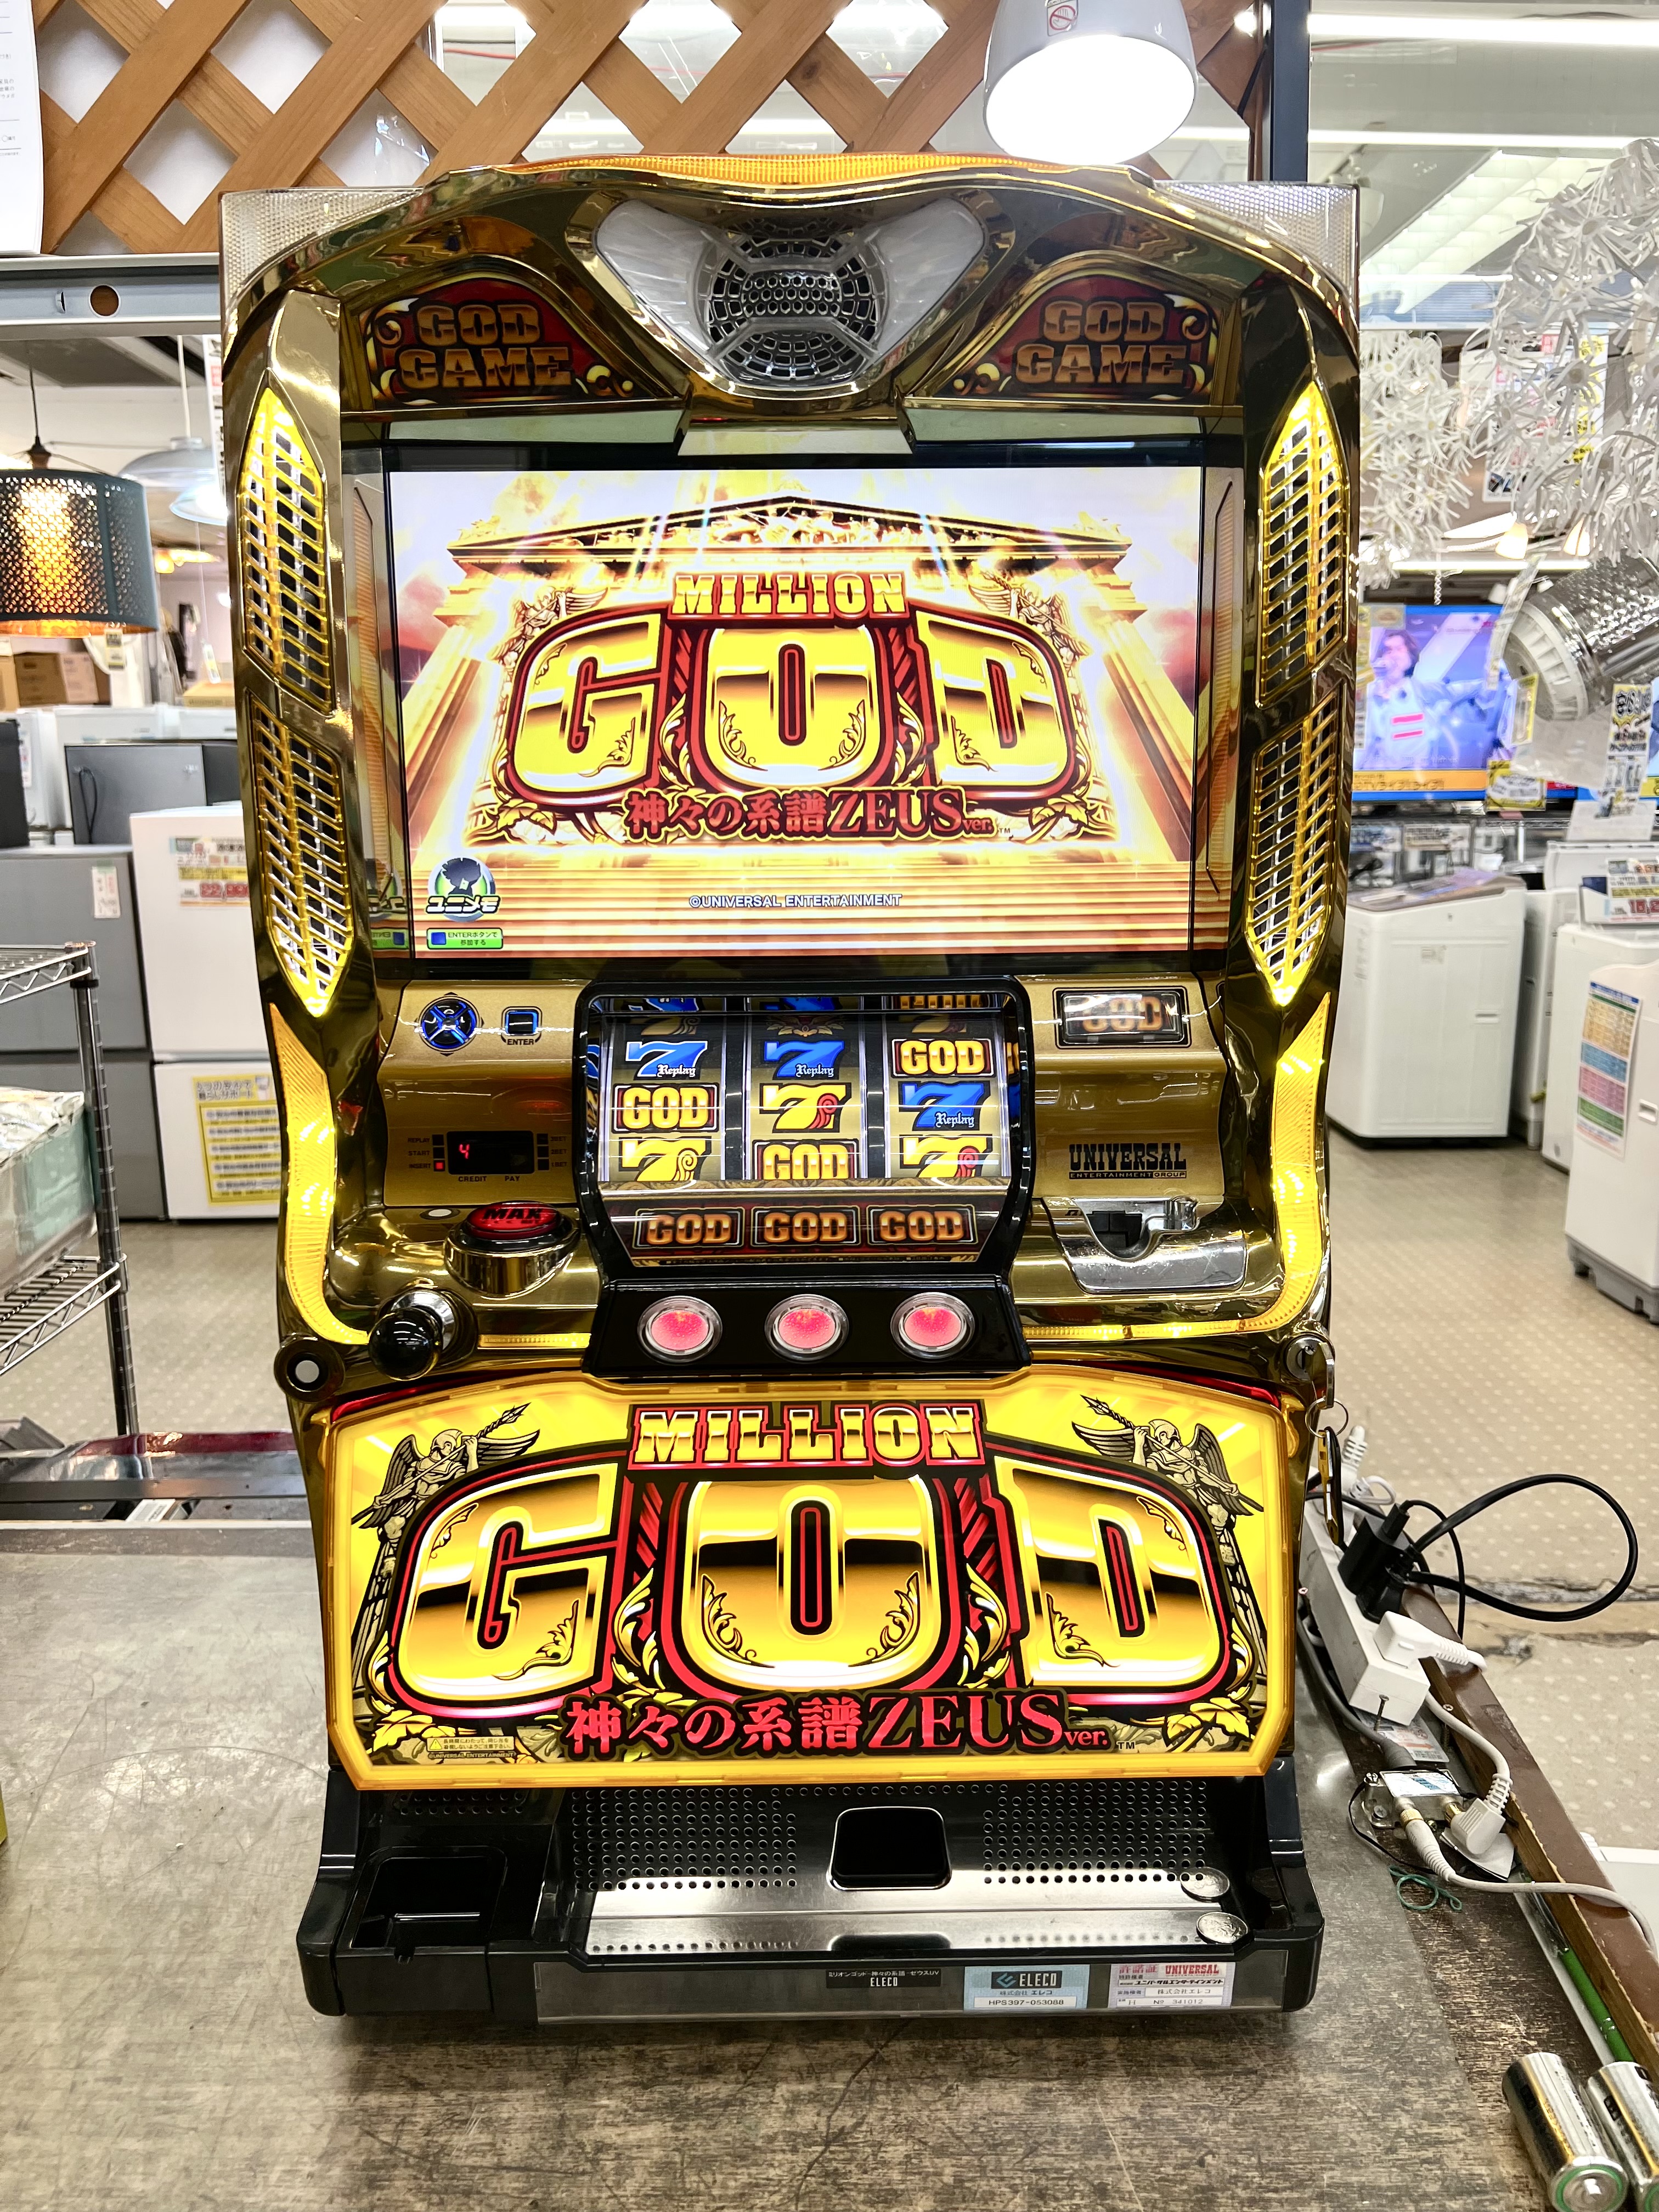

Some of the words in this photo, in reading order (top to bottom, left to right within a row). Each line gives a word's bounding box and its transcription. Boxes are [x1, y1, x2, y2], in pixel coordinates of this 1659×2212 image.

[417, 304, 540, 346] GOD
[1043, 301, 1165, 342] GOD
[399, 347, 572, 389] GAME
[1015, 345, 1186, 383] GAME
[674, 574, 906, 616] MILLION
[511, 611, 1071, 790] GOD
[426, 894, 500, 914] ユニメモ
[786, 894, 902, 908] ENTERTAINMENT
[1081, 995, 1163, 1032] GOD
[657, 1064, 696, 1078] Replay
[795, 1063, 834, 1078] Replay
[901, 1040, 984, 1075] GOD
[623, 1087, 709, 1130] GOD
[935, 1111, 974, 1128] Replay
[459, 1144, 470, 1159] 4
[763, 1144, 849, 1180] GOD
[1069, 1143, 1187, 1171] UNIVERSAL
[646, 1214, 731, 1244] GOD
[764, 1212, 847, 1243] GOD
[880, 1210, 964, 1242] GOD
[635, 1406, 982, 1464] MILLION
[403, 1459, 1221, 1700] GOD
[870, 1977, 898, 1987] ELECO
[1019, 1973, 1057, 1987] ELECO
[1165, 1964, 1219, 1974] UNIVERSAL
